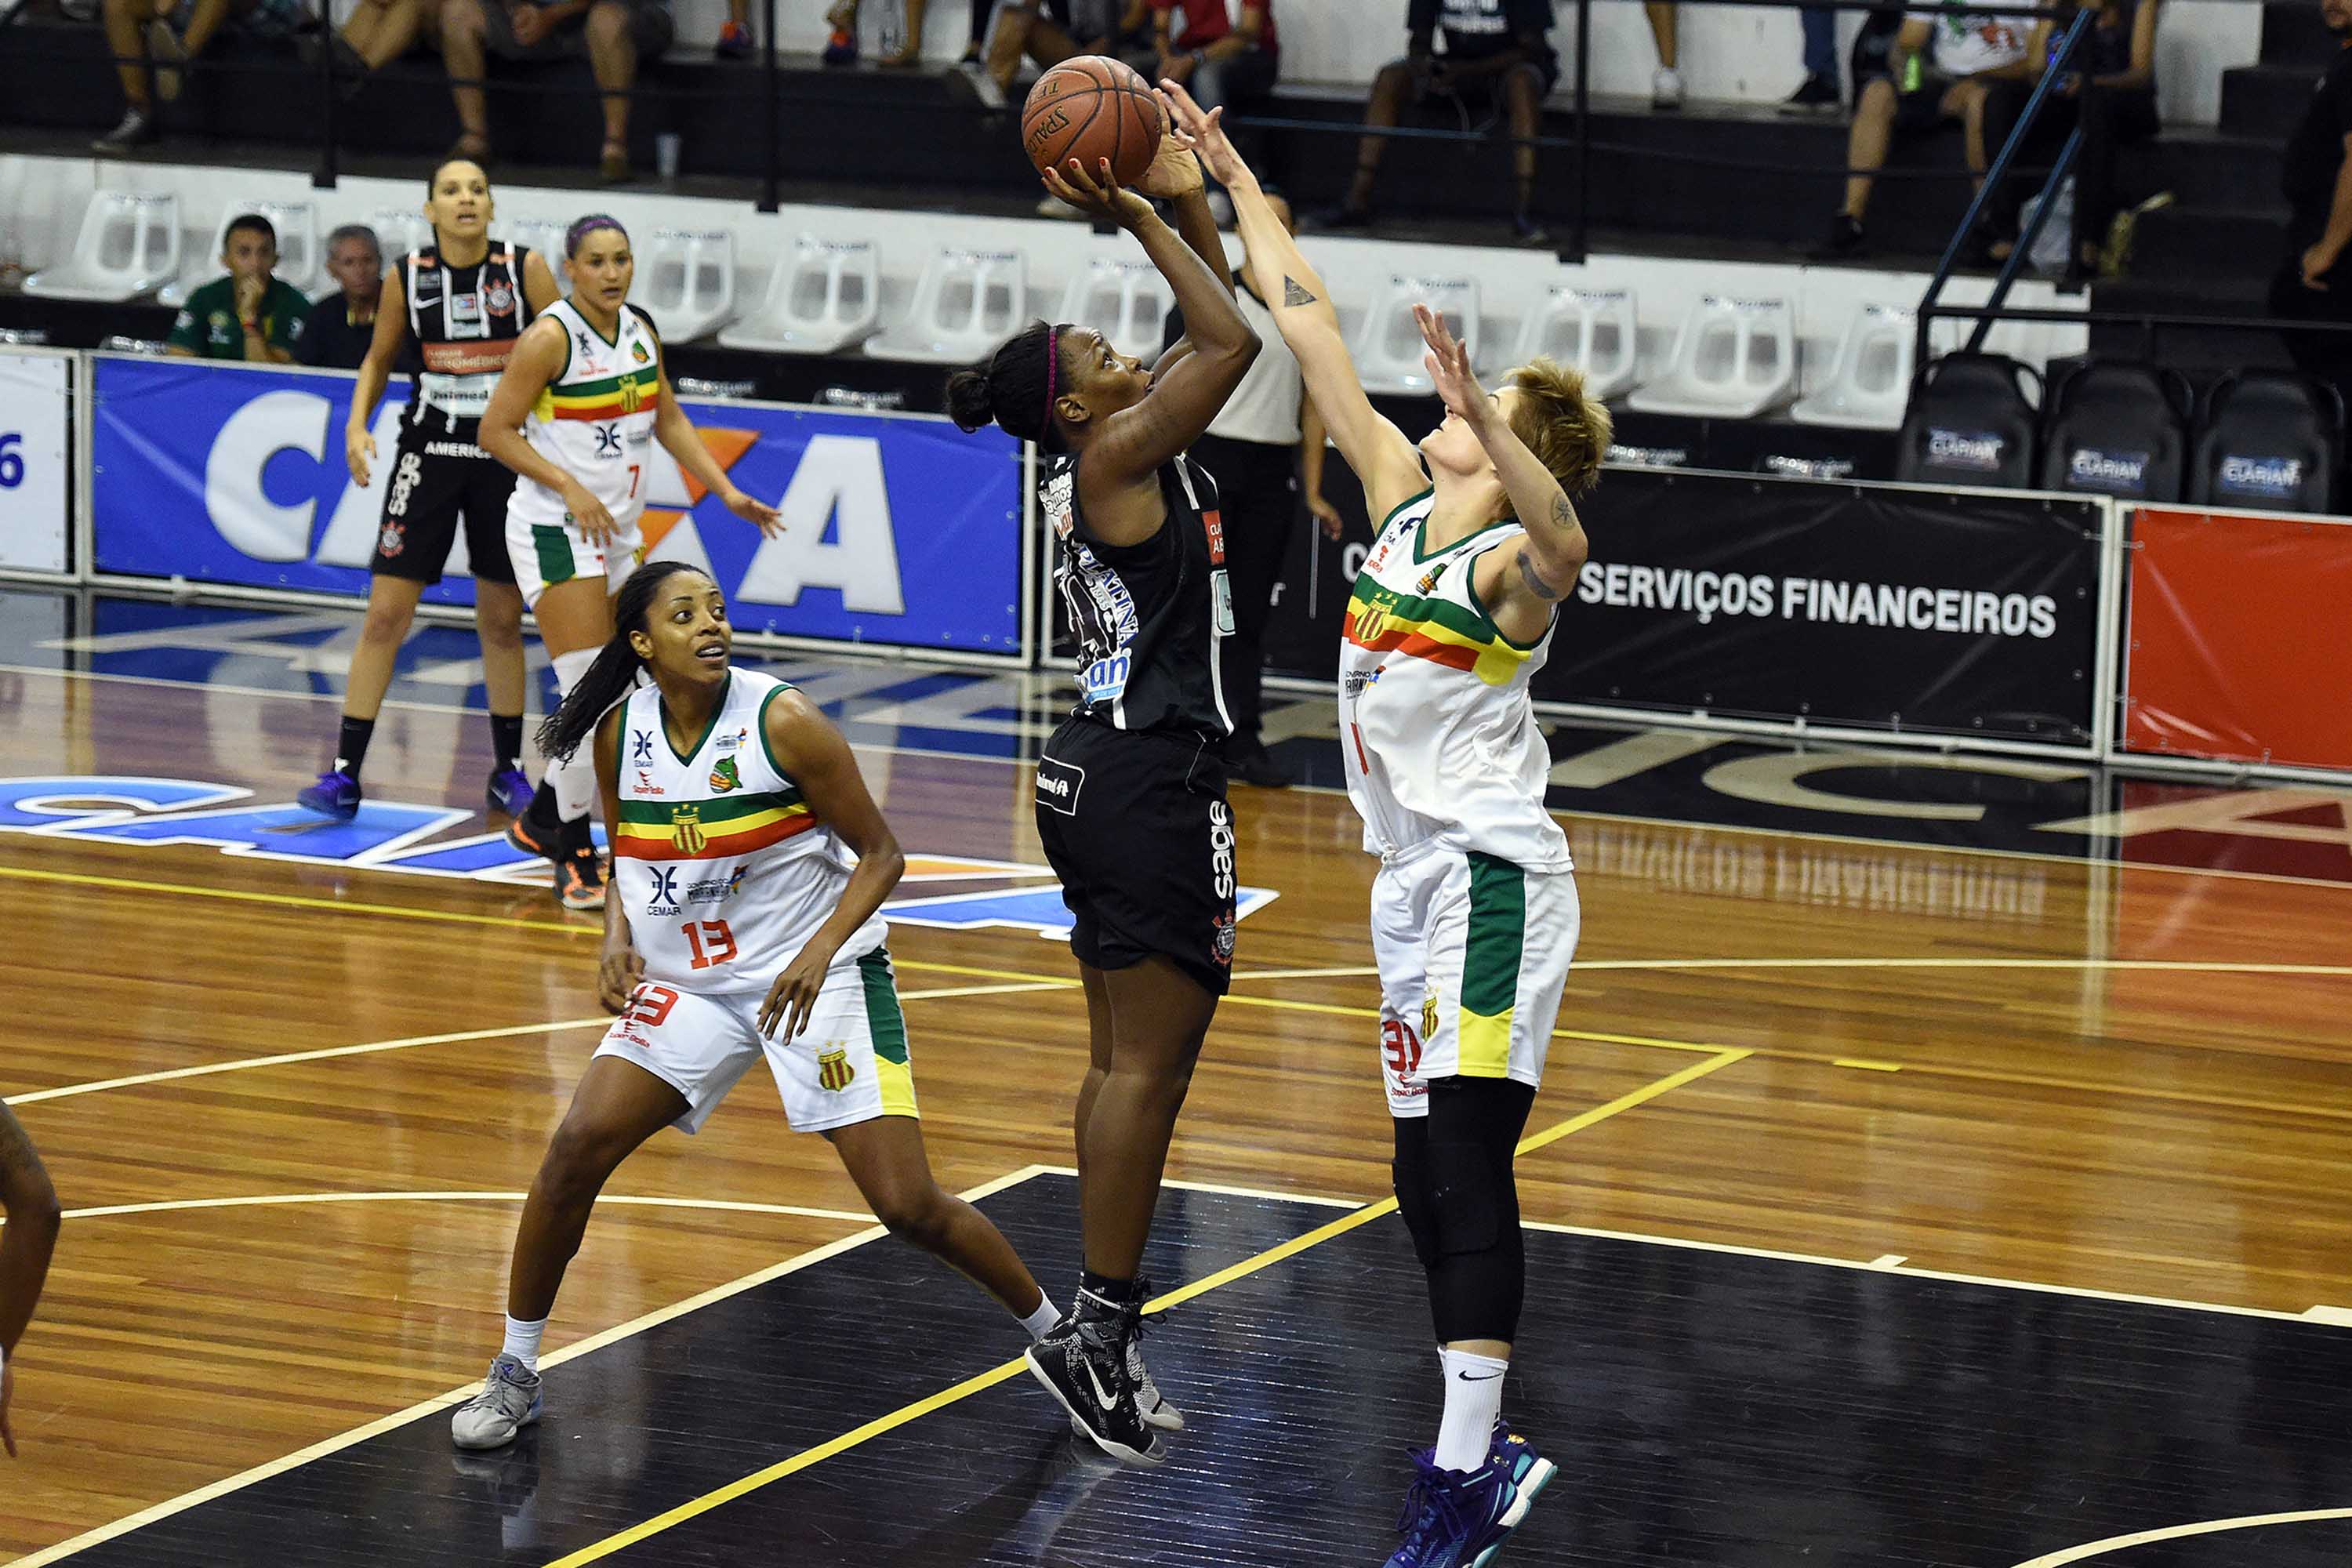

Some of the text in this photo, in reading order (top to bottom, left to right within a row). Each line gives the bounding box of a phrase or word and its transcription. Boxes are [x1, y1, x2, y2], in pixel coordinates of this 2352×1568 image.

[388, 452, 422, 517] sage
[628, 465, 640, 499] 7
[1078, 544, 1140, 649] PLATINA
[1577, 562, 2056, 638] SERVIÇOS FINANCEIROS
[1210, 800, 1236, 899] sage
[647, 906, 682, 916] CEMAR
[681, 918, 739, 970] 13
[1382, 1020, 1421, 1073] 31
